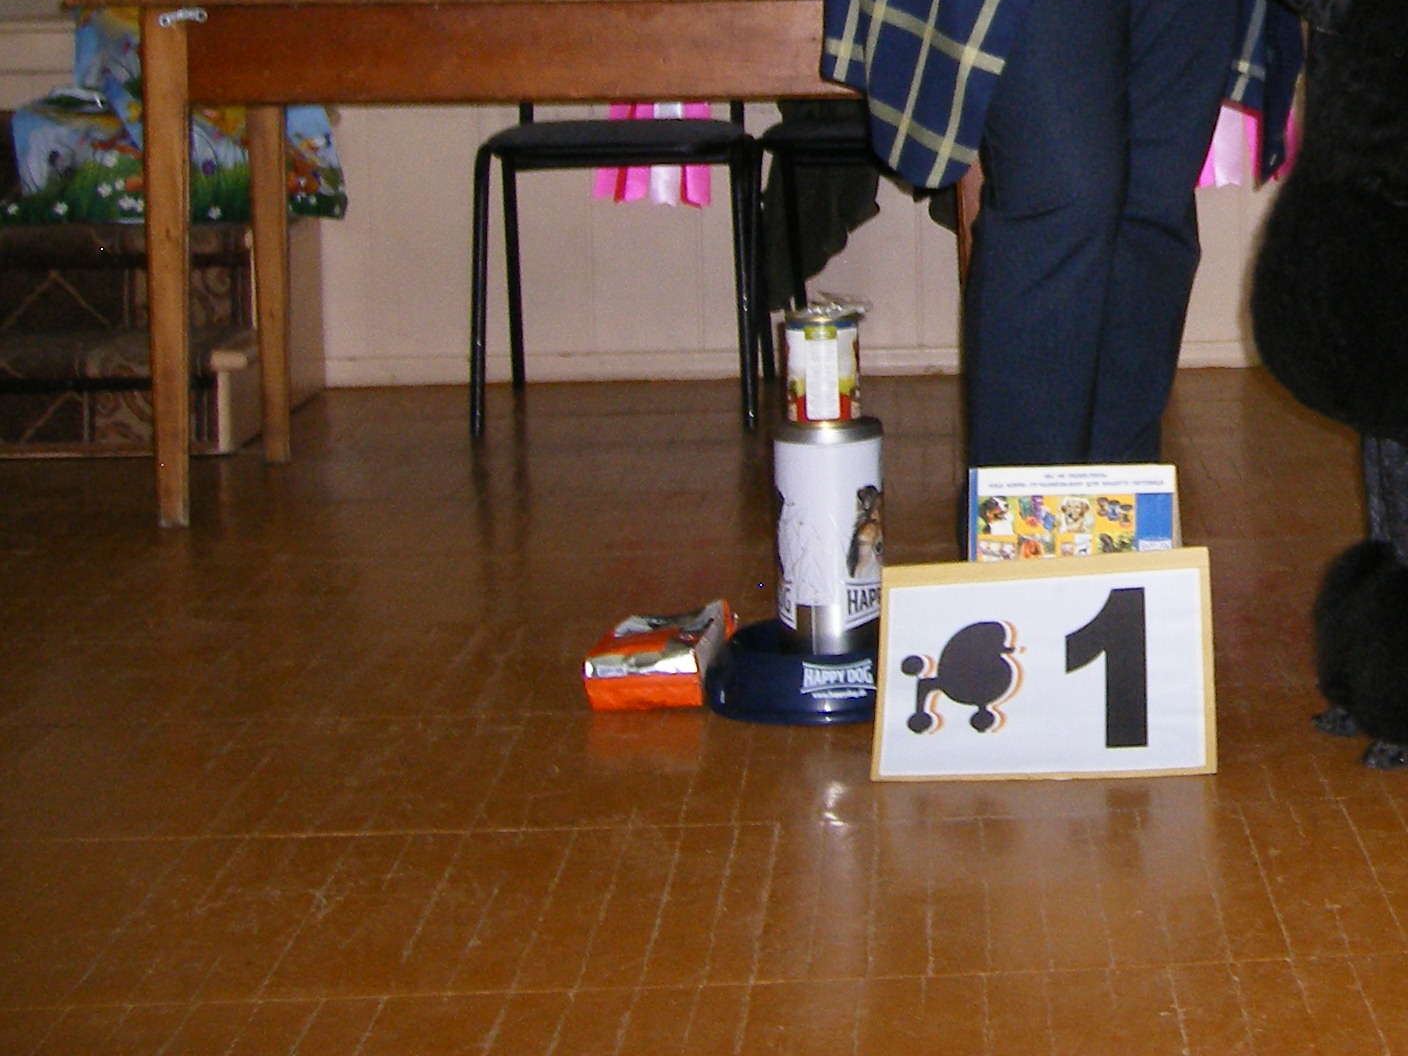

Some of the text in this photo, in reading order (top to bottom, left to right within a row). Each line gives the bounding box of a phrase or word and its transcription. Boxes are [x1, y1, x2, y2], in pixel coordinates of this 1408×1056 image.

[846, 586, 881, 616] HAP
[802, 665, 875, 689] HAPPY DOG
[1065, 587, 1149, 748] 1
